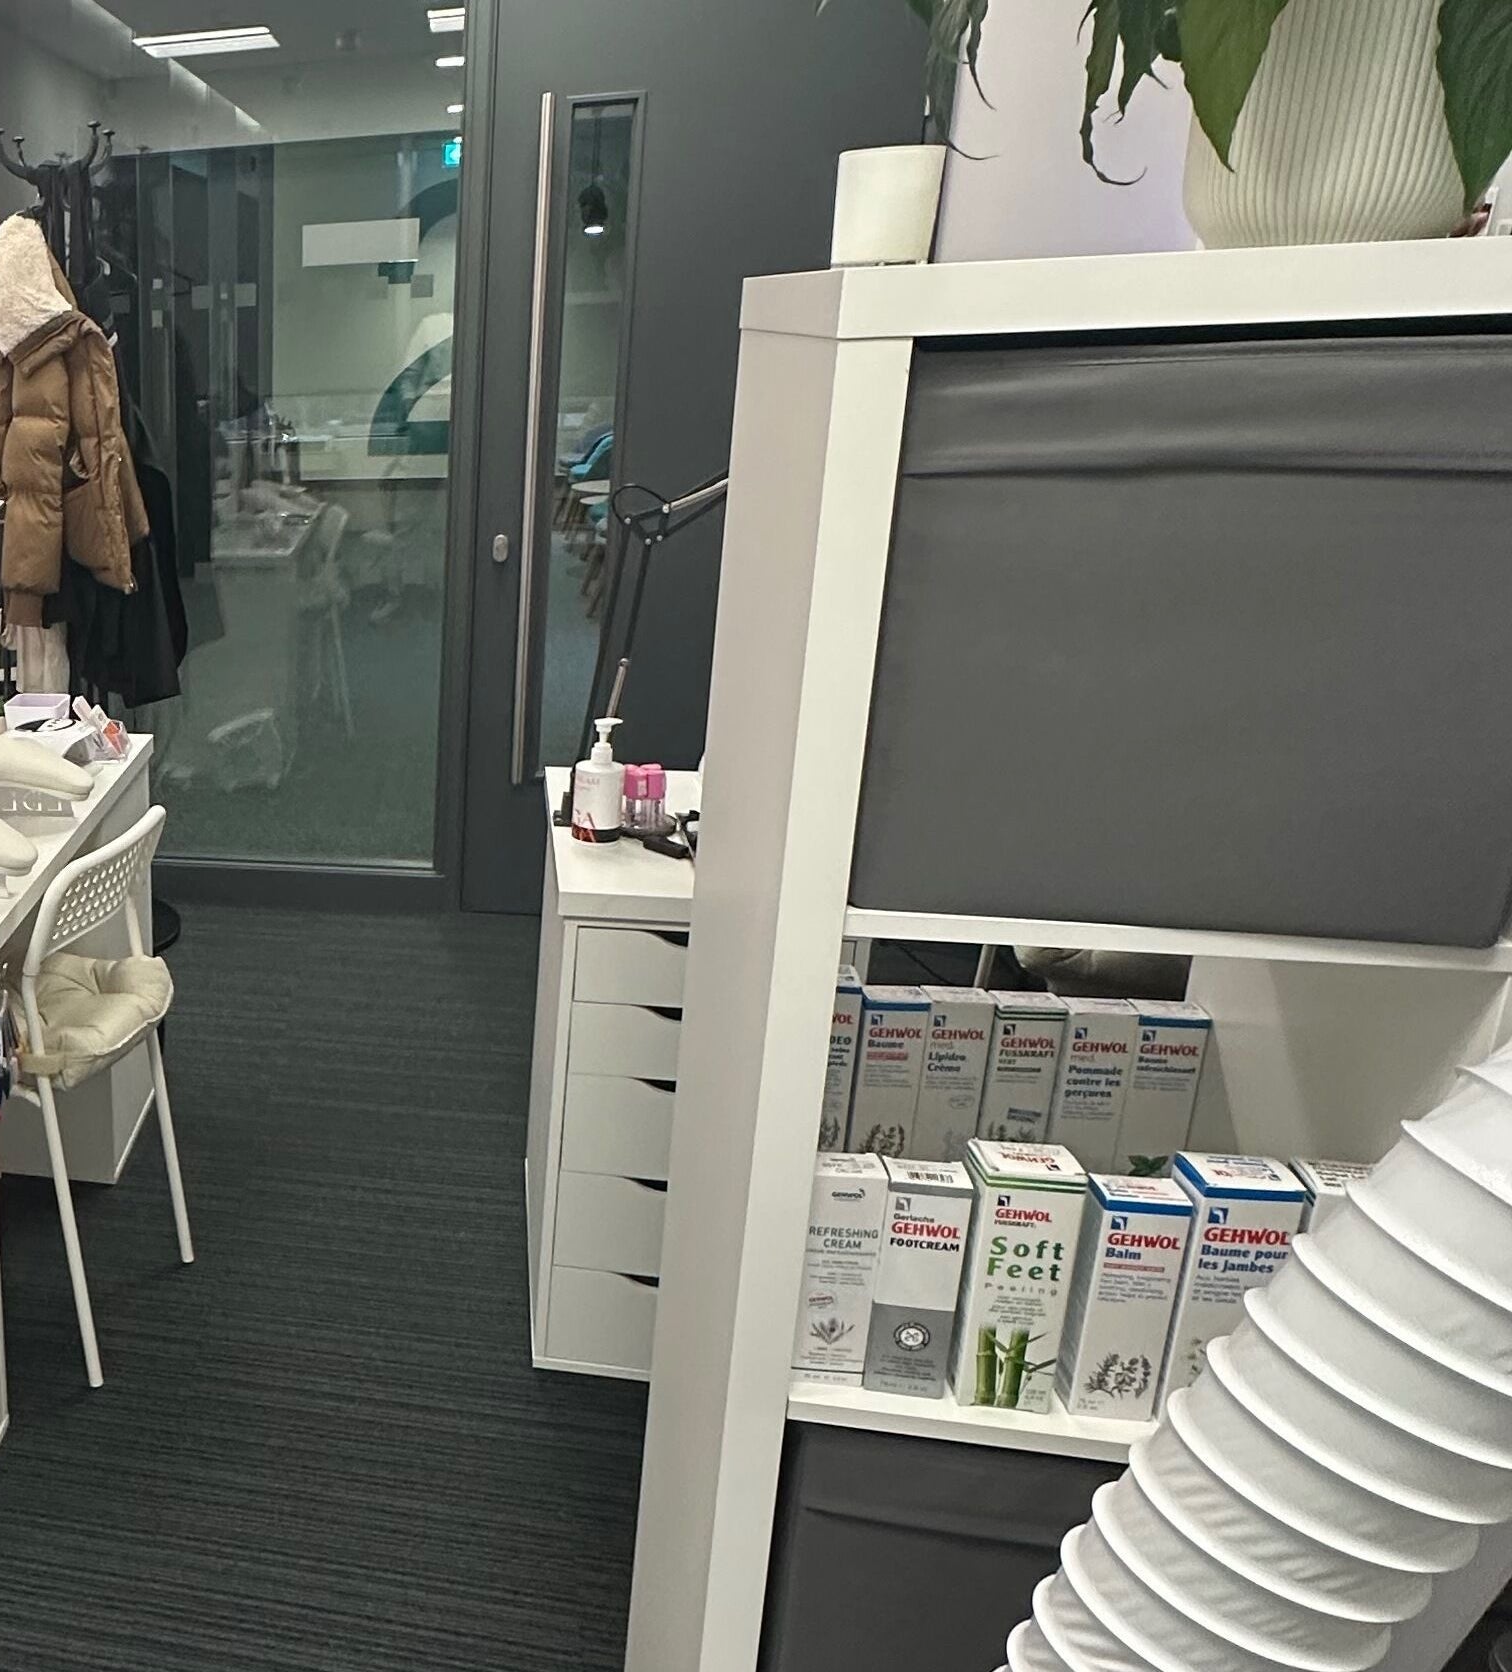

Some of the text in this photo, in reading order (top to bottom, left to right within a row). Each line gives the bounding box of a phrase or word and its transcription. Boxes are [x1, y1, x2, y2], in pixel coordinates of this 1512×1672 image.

[869, 1027, 922, 1039] GEHWOL
[932, 1028, 985, 1040] GEHWOL
[868, 1039, 904, 1049] Baume
[1000, 1037, 1056, 1049] GEHWOL
[1072, 1041, 1129, 1054] GEHWOL
[1140, 1043, 1199, 1057] GEHWOL
[1068, 1064, 1123, 1076] Pommade
[1066, 1077, 1121, 1087] contre les
[995, 1208, 1052, 1223] GEHWOL
[809, 1225, 879, 1239] REFRESHING
[891, 1221, 961, 1240] GEHWOL
[1203, 1226, 1291, 1246] GEHWOL
[823, 1238, 862, 1249] CREAM
[890, 1237, 960, 1252] FOOTCREAM
[1107, 1232, 1181, 1250] GEHWOL
[990, 1236, 1065, 1261] Soft
[1105, 1246, 1141, 1260] Balm
[1200, 1244, 1289, 1265] Baume pour
[987, 1257, 1062, 1281] Feet
[1197, 1258, 1218, 1270] les
